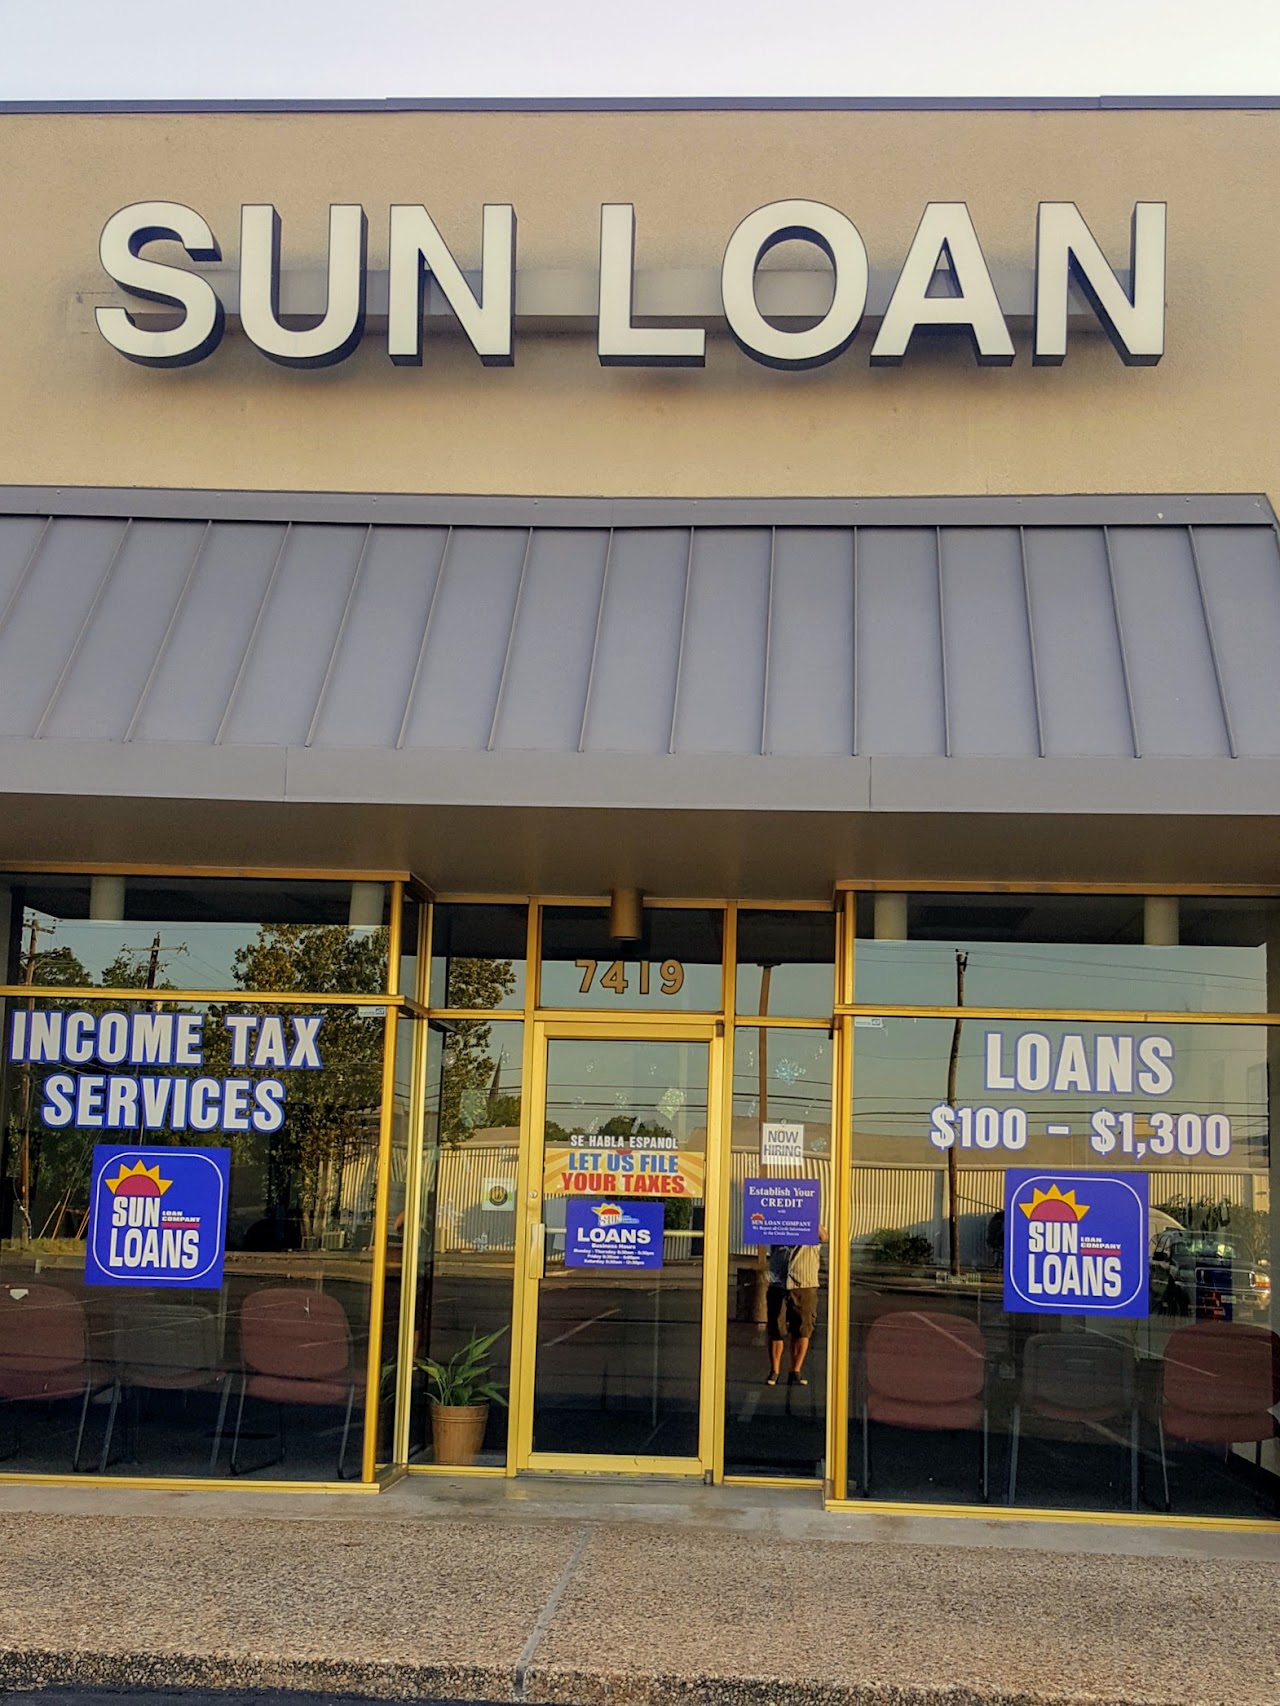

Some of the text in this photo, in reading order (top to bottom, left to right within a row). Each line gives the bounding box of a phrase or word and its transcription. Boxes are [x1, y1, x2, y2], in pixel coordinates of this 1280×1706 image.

[95, 198, 1167, 370] SUN LOAN
[575, 958, 685, 995] 7419
[9, 1009, 323, 1070] INCOME TAX
[984, 1030, 1175, 1095] LOANS
[40, 1072, 286, 1133] SERVICES
[570, 1135, 678, 1150] SE HABLA ESPANOL
[768, 1130, 799, 1144] NOW
[930, 1103, 1028, 1151] $100
[1089, 1107, 1233, 1162] $1,300
[568, 1152, 679, 1173] LET US FILE
[763, 1144, 801, 1158] HIRING
[561, 1172, 685, 1194] YOUR TAXES
[749, 1186, 815, 1197] Establish Your
[112, 1196, 160, 1228] SUN
[760, 1197, 803, 1208] CREDIT
[577, 1227, 651, 1244] LOANS
[782, 1220, 811, 1228] COMPANY
[1029, 1221, 1078, 1253] SUN
[109, 1228, 200, 1269] LOANS
[1080, 1242, 1122, 1250] COMPANY
[1028, 1253, 1122, 1297] LOANS
